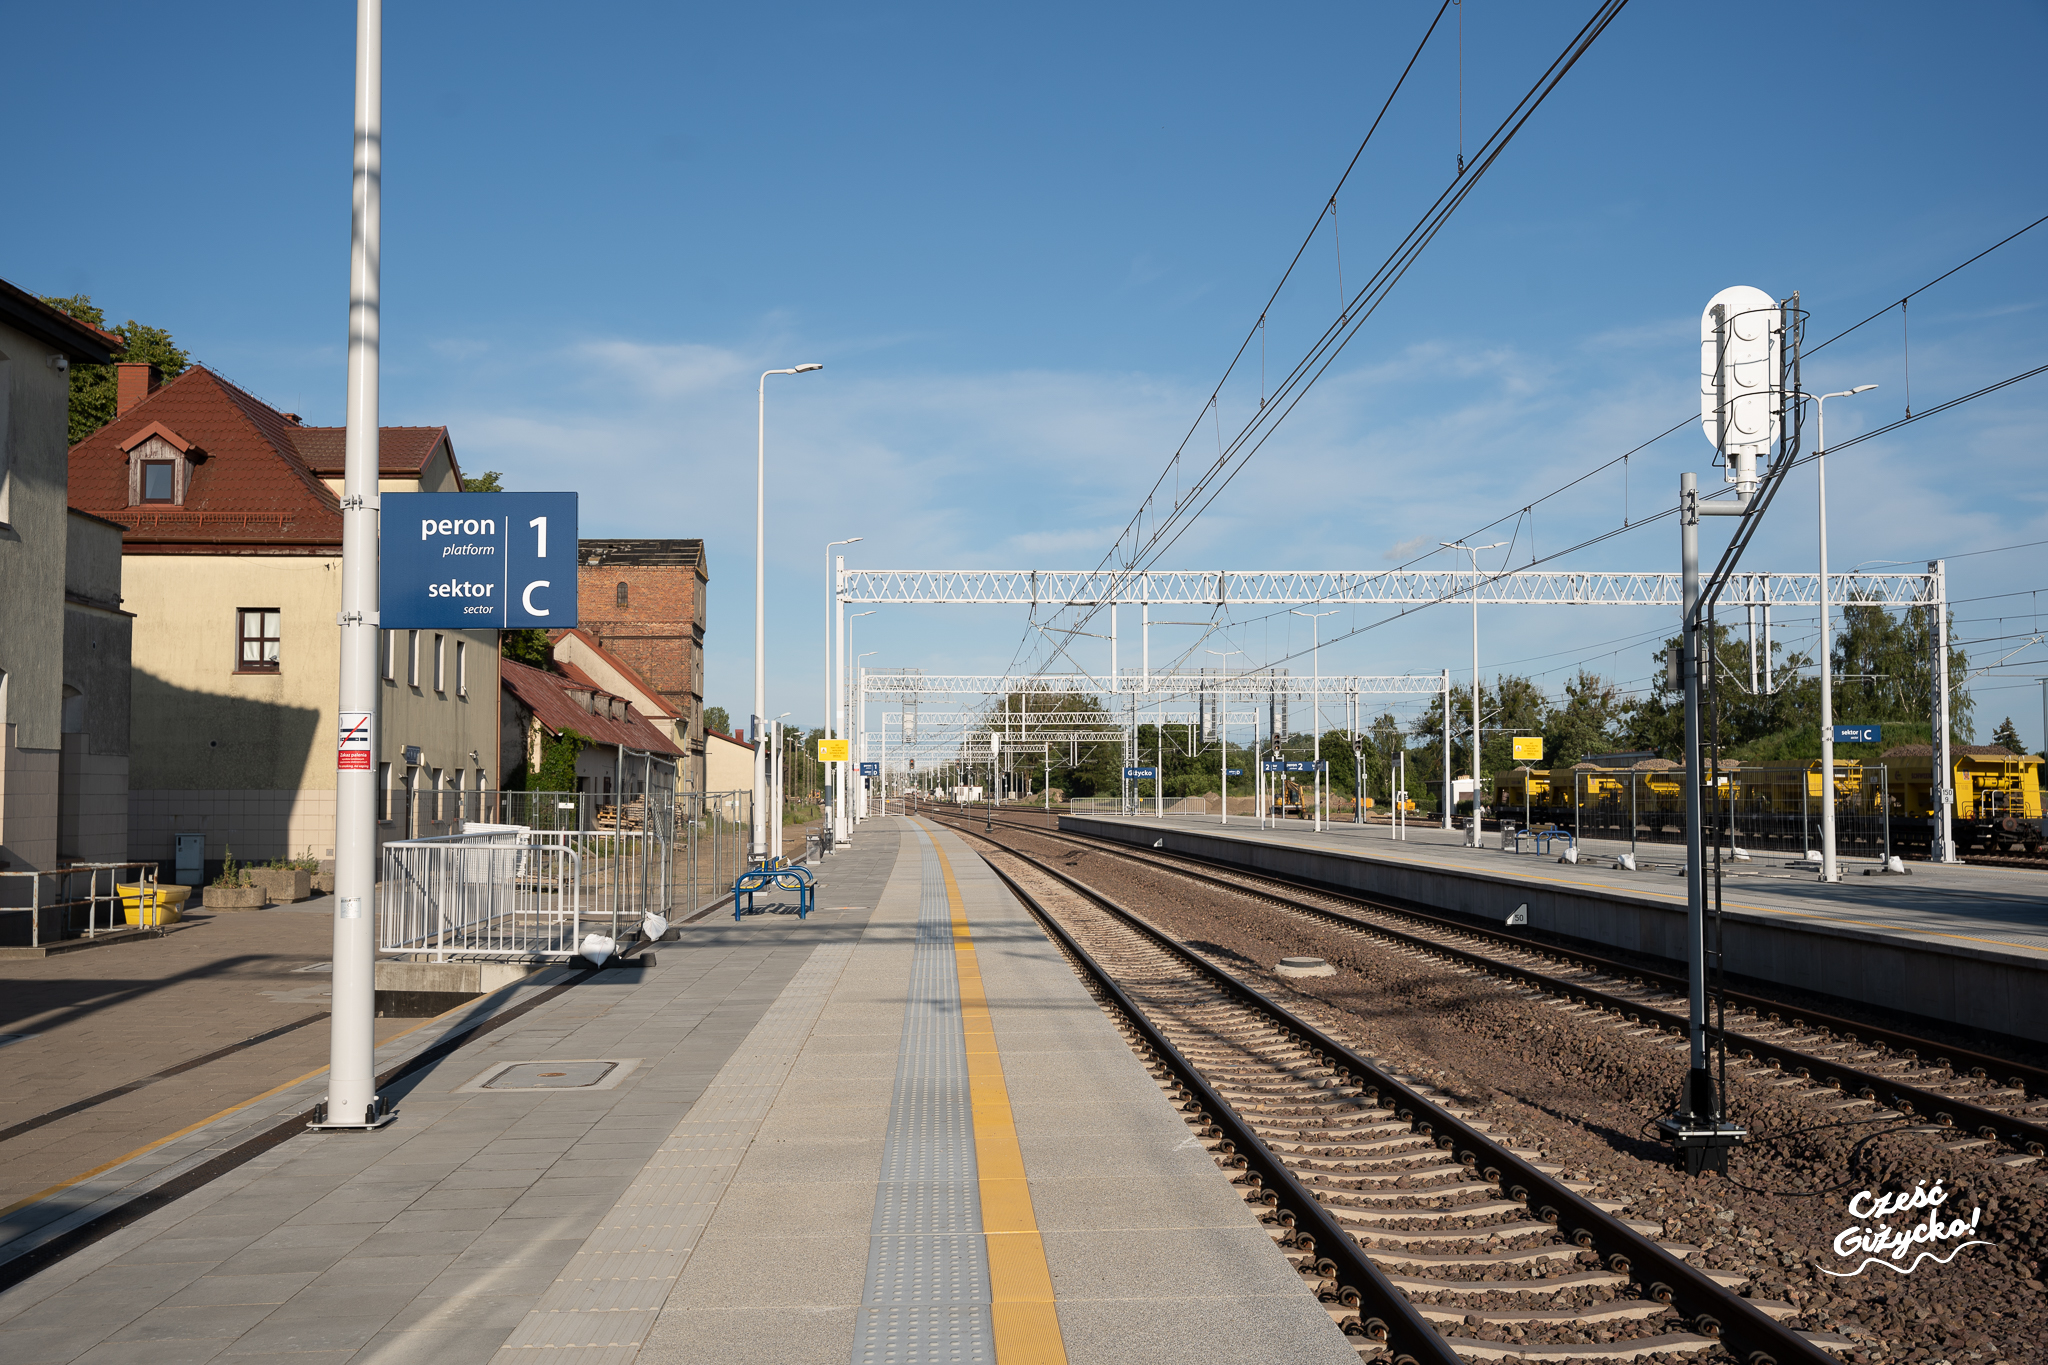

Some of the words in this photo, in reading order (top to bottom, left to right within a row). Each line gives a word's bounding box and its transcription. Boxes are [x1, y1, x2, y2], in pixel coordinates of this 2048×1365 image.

[421, 519, 495, 541] peron
[529, 516, 547, 558] 1
[442, 543, 495, 558] platform
[428, 579, 494, 598] sektor
[522, 580, 550, 617] C
[463, 604, 494, 615] sector
[1864, 730, 1872, 740] C
[1265, 763, 1270, 771] 2
[1298, 763, 1304, 771] 2
